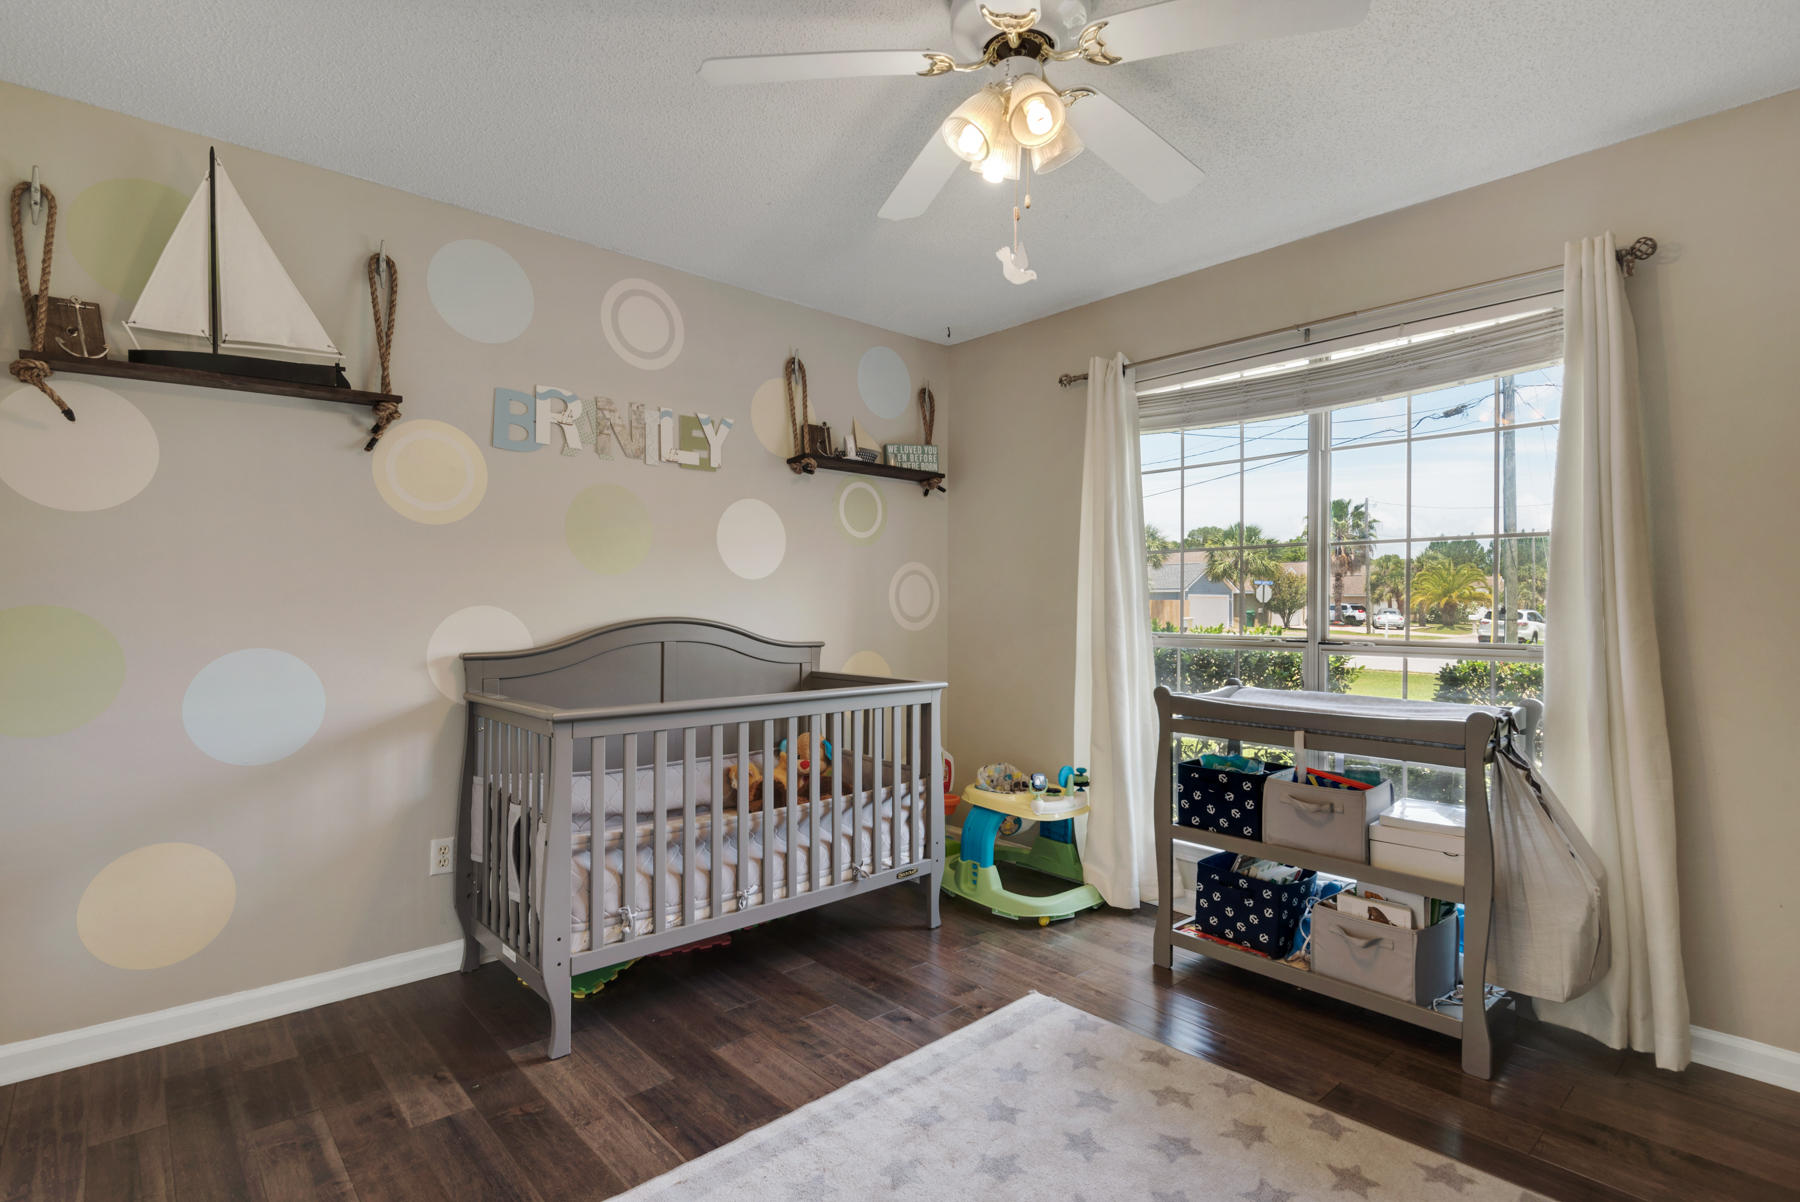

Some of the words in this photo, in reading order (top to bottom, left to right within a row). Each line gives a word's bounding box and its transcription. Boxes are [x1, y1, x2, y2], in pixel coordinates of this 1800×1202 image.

[887, 445, 898, 453] WE
[900, 445, 922, 454] LOVED
[923, 445, 937, 454] YOU
[909, 454, 937, 462] BEFORE
